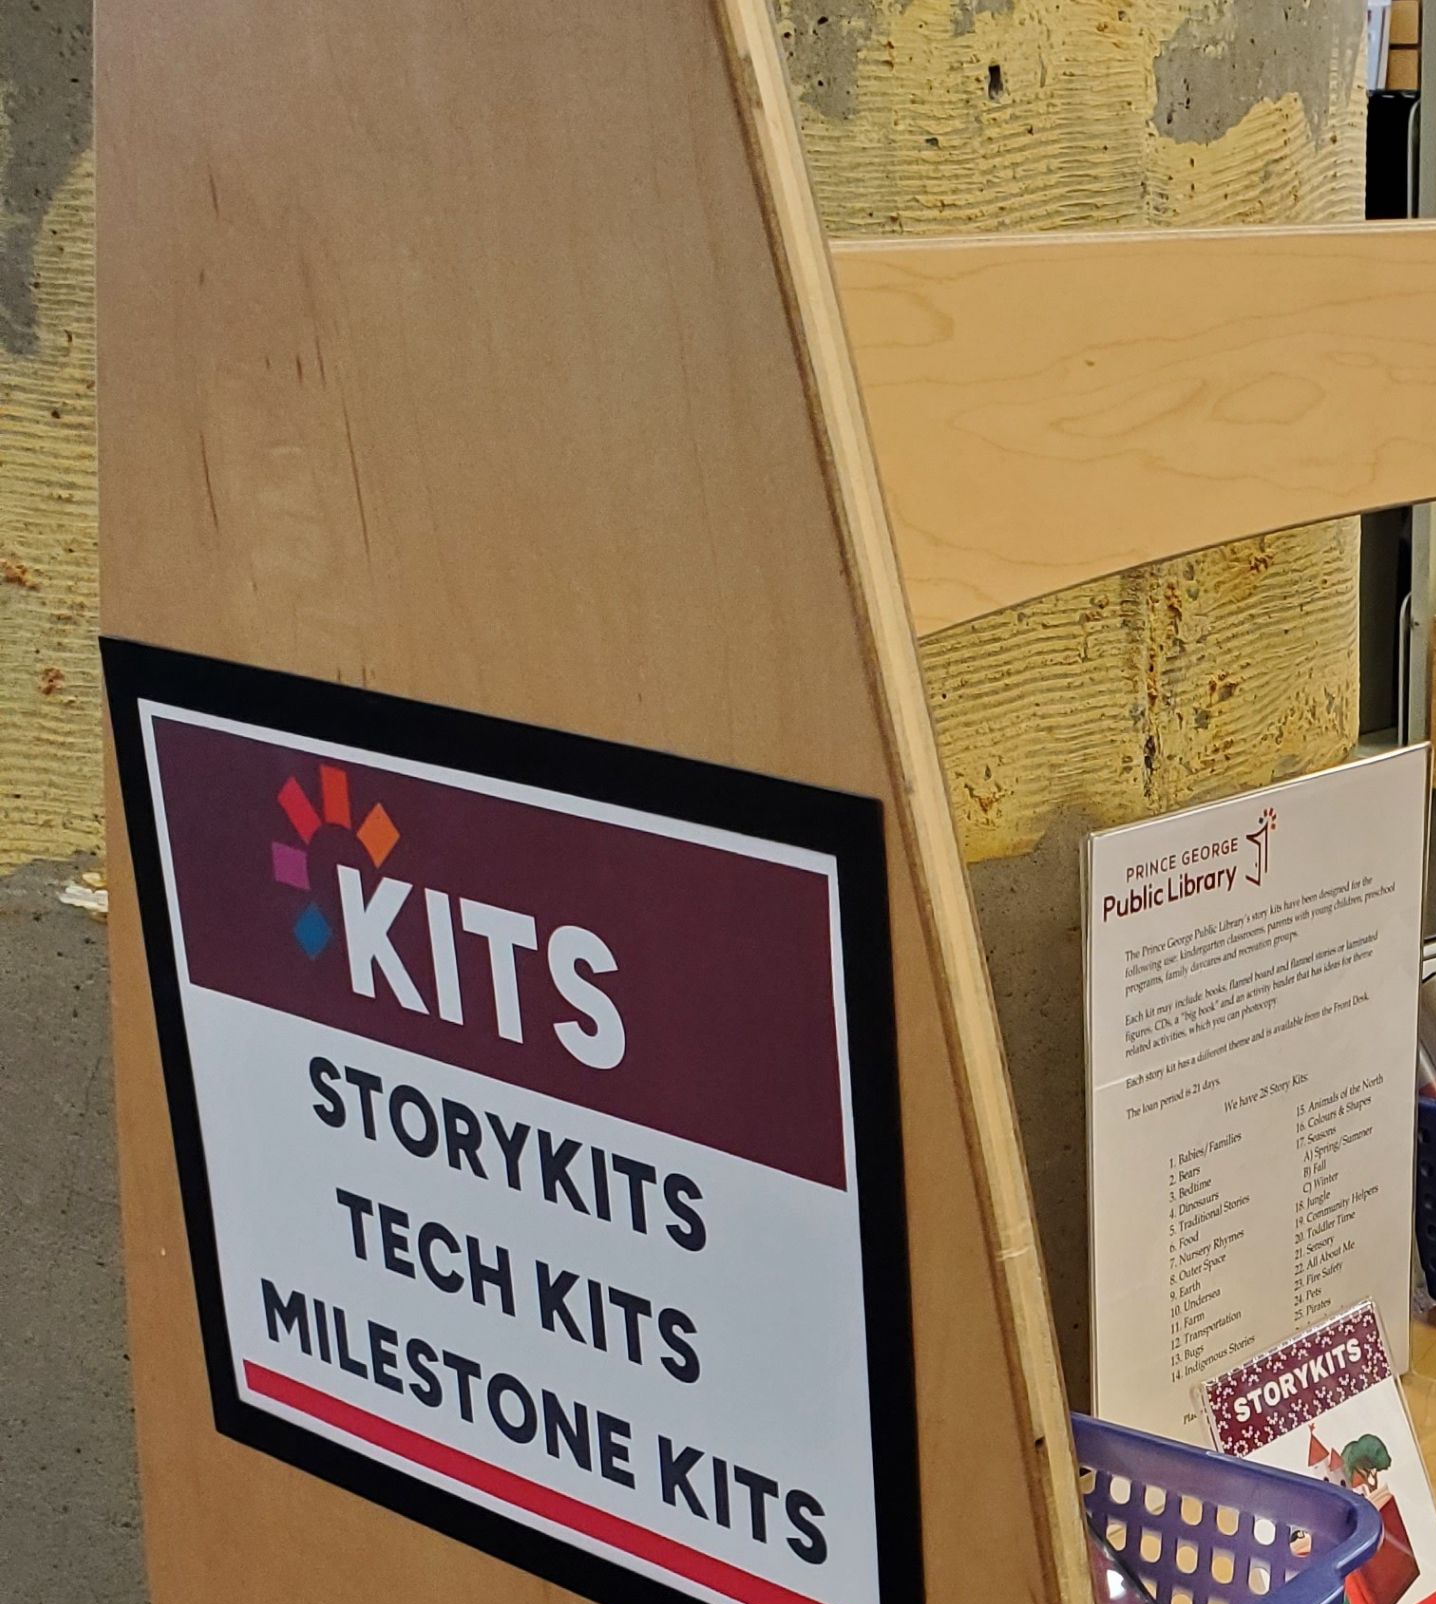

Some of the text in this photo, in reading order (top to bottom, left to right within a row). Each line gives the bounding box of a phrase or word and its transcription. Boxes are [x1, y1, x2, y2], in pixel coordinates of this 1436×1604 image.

[1126, 837, 1238, 882] PRINCE GEORGE
[1103, 866, 1237, 922] Public Library
[1125, 949, 1141, 962] The
[1141, 943, 1166, 957] Prince
[1166, 933, 1193, 949] George
[1194, 924, 1217, 940] Public
[336, 865, 626, 1070] KITS
[1126, 1107, 1141, 1120] The
[1142, 1101, 1159, 1114] loan
[1160, 1089, 1184, 1110] period
[1224, 1099, 1238, 1113] We
[1239, 1093, 1259, 1107] have
[1269, 1080, 1290, 1095] Story
[1308, 1092, 1339, 1113] Animals
[1339, 1087, 1348, 1100] of
[1349, 1084, 1361, 1096] the
[1362, 1073, 1384, 1090] North
[1307, 1110, 1337, 1128] Colours
[1338, 1105, 1345, 1116] &
[1345, 1096, 1372, 1113] Shapes
[1307, 1127, 1337, 1145] Seasons
[308, 1056, 709, 1253] STORYKITS
[1313, 1159, 1327, 1175] Fall
[1178, 1166, 1201, 1182] Bears
[1313, 1172, 1339, 1189] Winter
[1178, 1179, 1212, 1199] Bedtime
[1307, 1189, 1331, 1209] Jungle
[1178, 1192, 1219, 1216] Dinosaurs
[1179, 1204, 1223, 1232] Traditional
[1223, 1195, 1250, 1213] Stories
[1306, 1198, 1350, 1223] Community
[1351, 1185, 1379, 1204] Helpers
[1179, 1230, 1199, 1249] Food
[1307, 1219, 1336, 1239] Toddler
[1336, 1211, 1356, 1225] Time
[1179, 1244, 1211, 1265] Nursery
[1213, 1230, 1244, 1250] Rhymes
[1306, 1236, 1334, 1255] Sensory
[1306, 1255, 1319, 1271] All
[1319, 1246, 1342, 1264] About
[1342, 1240, 1355, 1253] Me
[1178, 1264, 1202, 1281] Outer
[1203, 1254, 1226, 1272] Space
[1306, 1273, 1321, 1286] Fire
[1321, 1262, 1342, 1278] Safety
[336, 1187, 701, 1386] TECH KITS
[1179, 1279, 1201, 1298] Earth
[1183, 1289, 1221, 1312] Undersea
[1306, 1287, 1322, 1301] Pets
[1183, 1312, 1205, 1329] Farm
[1306, 1299, 1332, 1316] Pirates
[1184, 1311, 1242, 1344] Transportation
[1184, 1344, 1204, 1360] Bugs
[1184, 1349, 1228, 1376] Indigenous
[1228, 1335, 1255, 1354] Stories
[1234, 1338, 1362, 1423] STORYKITS
[260, 1277, 827, 1567] MILESTONE KITS
